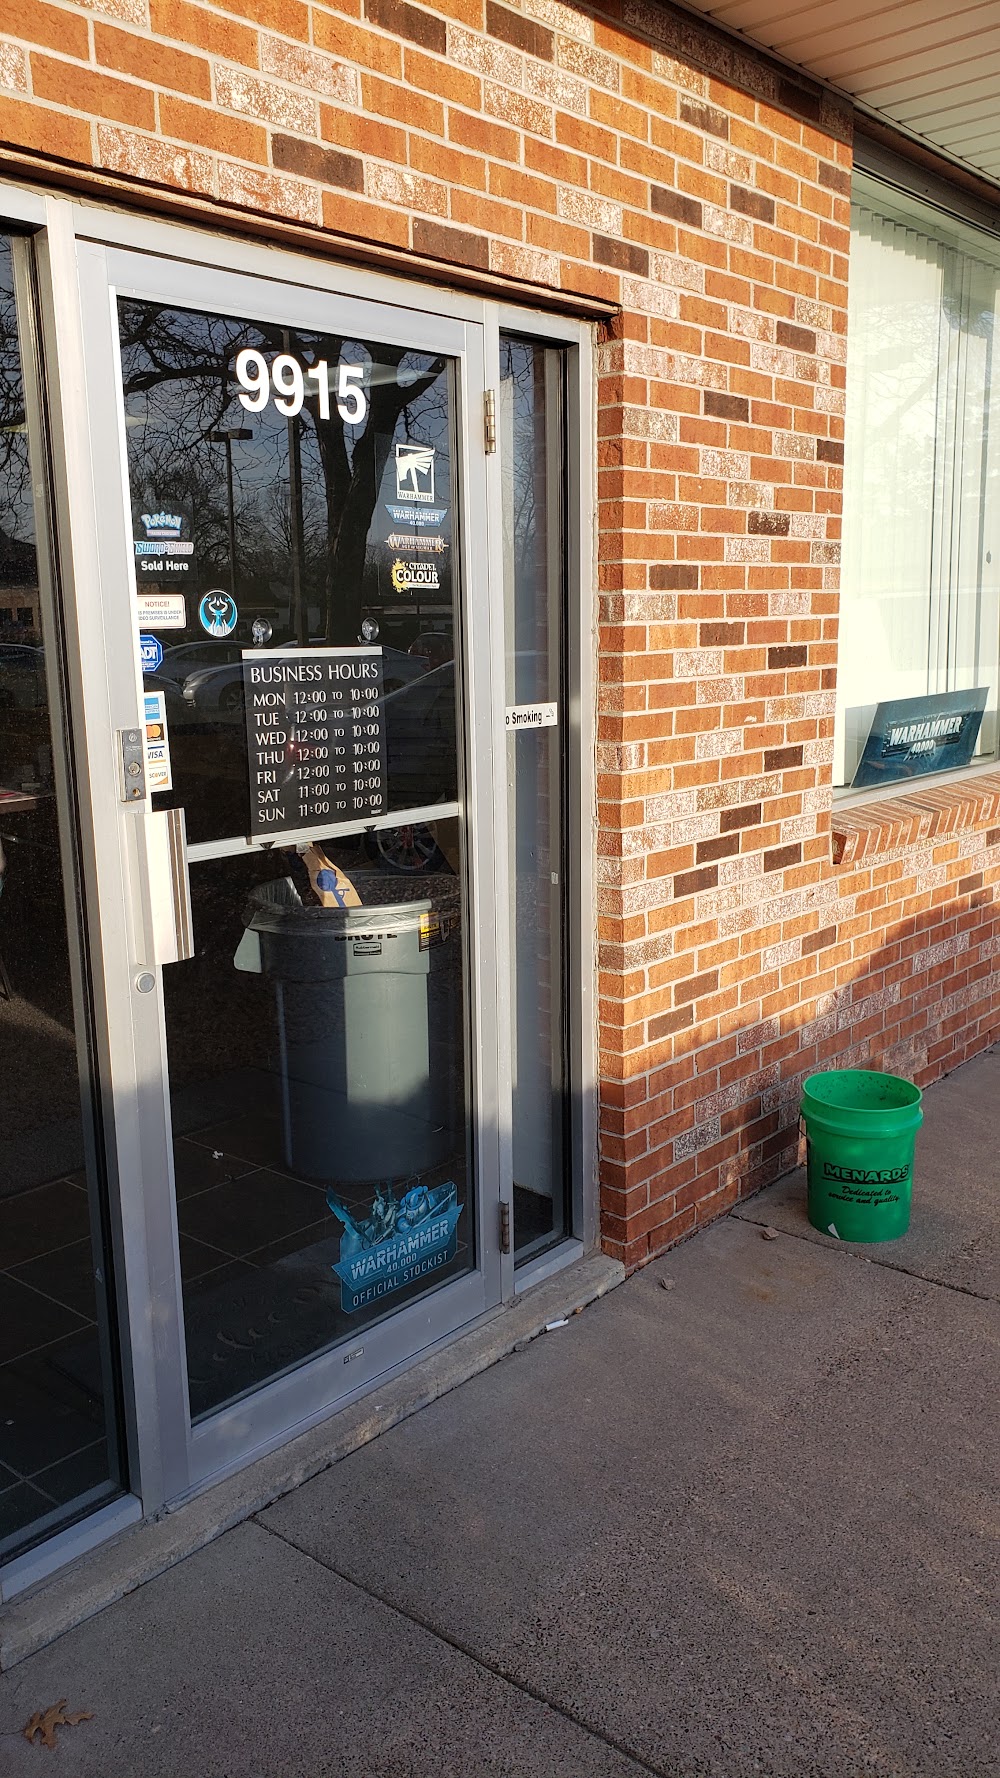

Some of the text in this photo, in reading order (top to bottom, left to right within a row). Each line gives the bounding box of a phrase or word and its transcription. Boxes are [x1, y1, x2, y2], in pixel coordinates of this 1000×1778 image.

[236, 349, 367, 424] 9915
[398, 491, 433, 502] WARHAMMER
[393, 509, 440, 522] WARHAMMER
[141, 561, 189, 570] Sold Here
[409, 562, 436, 571] CITADEL
[396, 570, 438, 583] COLOUR
[251, 663, 379, 683] BUSINESS HOURS
[253, 687, 379, 707] MON 12:00 TO 10:00
[254, 705, 380, 727] TUE 12:00 TO 10:00
[505, 710, 542, 725] o Smoking
[255, 724, 380, 746] WED 12:00 TO 10:00
[889, 716, 962, 747] WARHAMMER
[147, 750, 164, 760] VISA
[256, 741, 380, 765] THU 12:00 TO 10:00
[149, 771, 167, 779] SCOVER
[257, 759, 381, 784] FRI 12:00 TO 10:00
[258, 777, 381, 804] SAT 11:00 TO 10:00
[258, 794, 382, 823] SUN 11:00 TO 10:00
[823, 1162, 910, 1182] MENARDS
[828, 1191, 900, 1206] service and quality
[841, 1186, 883, 1197] Dedicated
[350, 1219, 449, 1280] WARHAMMER
[353, 1250, 448, 1307] OFFICIAL STOCKIST
